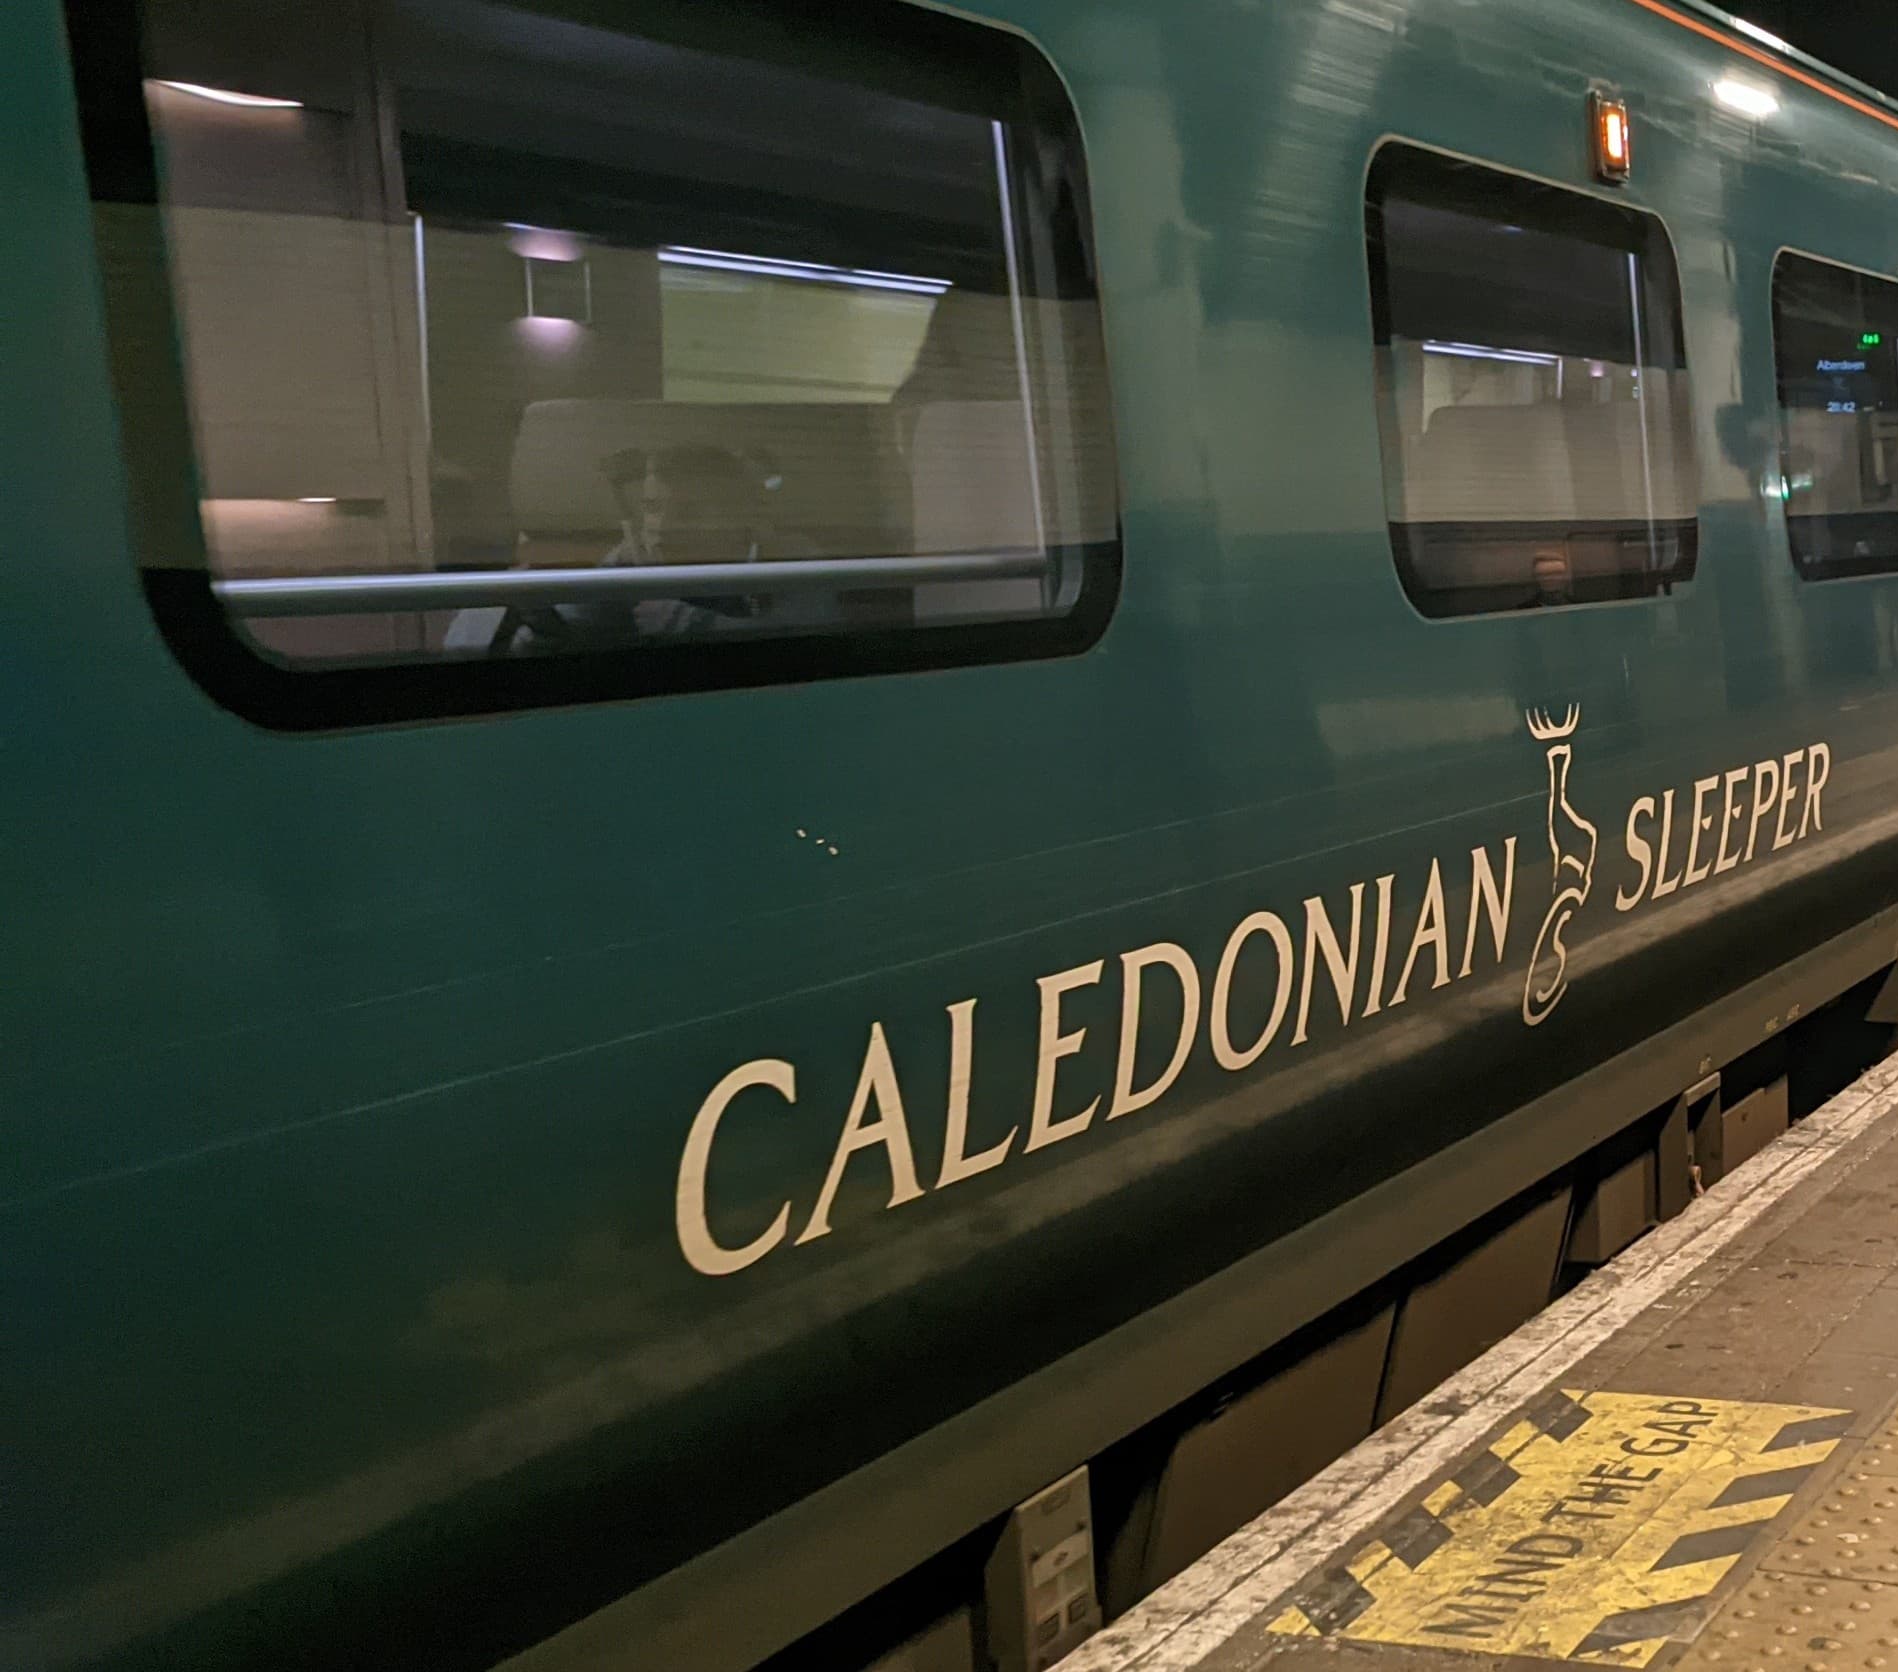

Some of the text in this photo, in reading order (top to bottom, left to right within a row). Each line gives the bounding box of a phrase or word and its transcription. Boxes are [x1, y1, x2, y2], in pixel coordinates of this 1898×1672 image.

[676, 742, 1831, 1276] CALEDONIAN SLEEPER
[1420, 1399, 1719, 1639] MIND THE GAP
